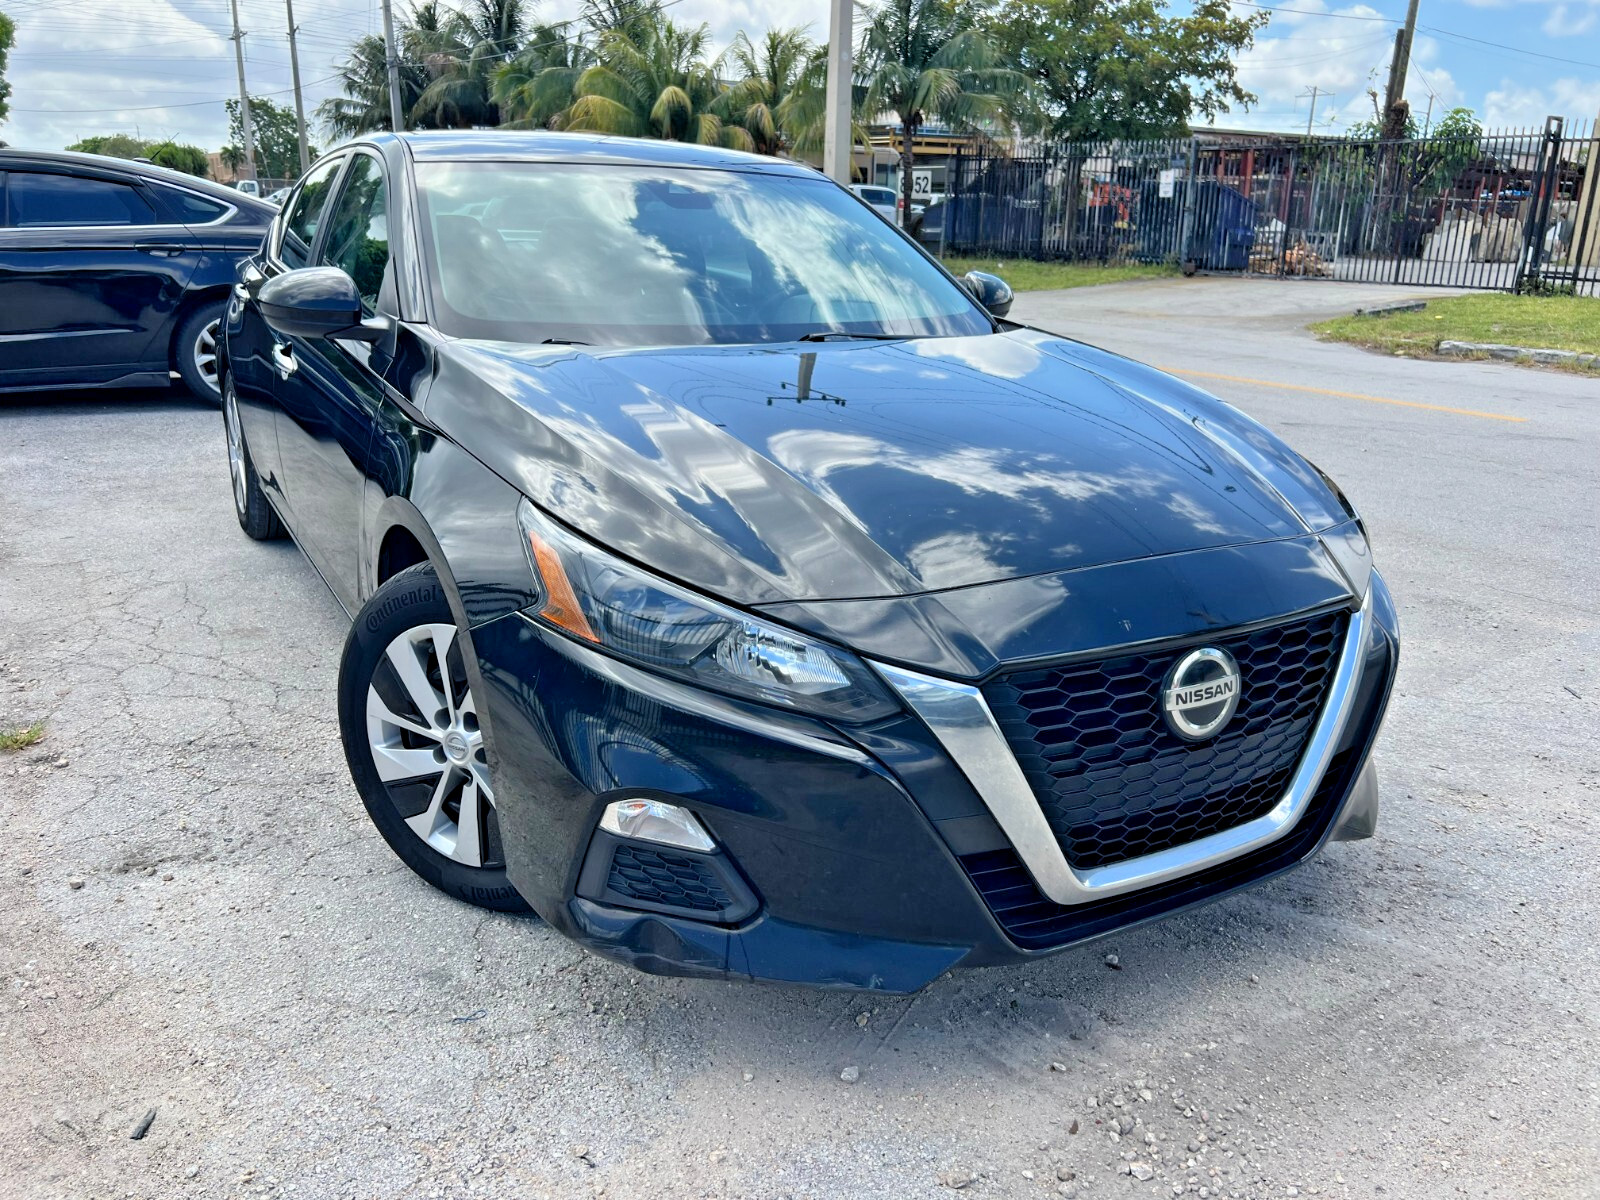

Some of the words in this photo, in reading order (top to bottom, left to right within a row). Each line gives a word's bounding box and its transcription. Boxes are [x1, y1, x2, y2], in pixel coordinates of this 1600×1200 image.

[900, 176, 929, 194] 852
[366, 585, 436, 633] Continental
[1175, 680, 1233, 706] NISSAN
